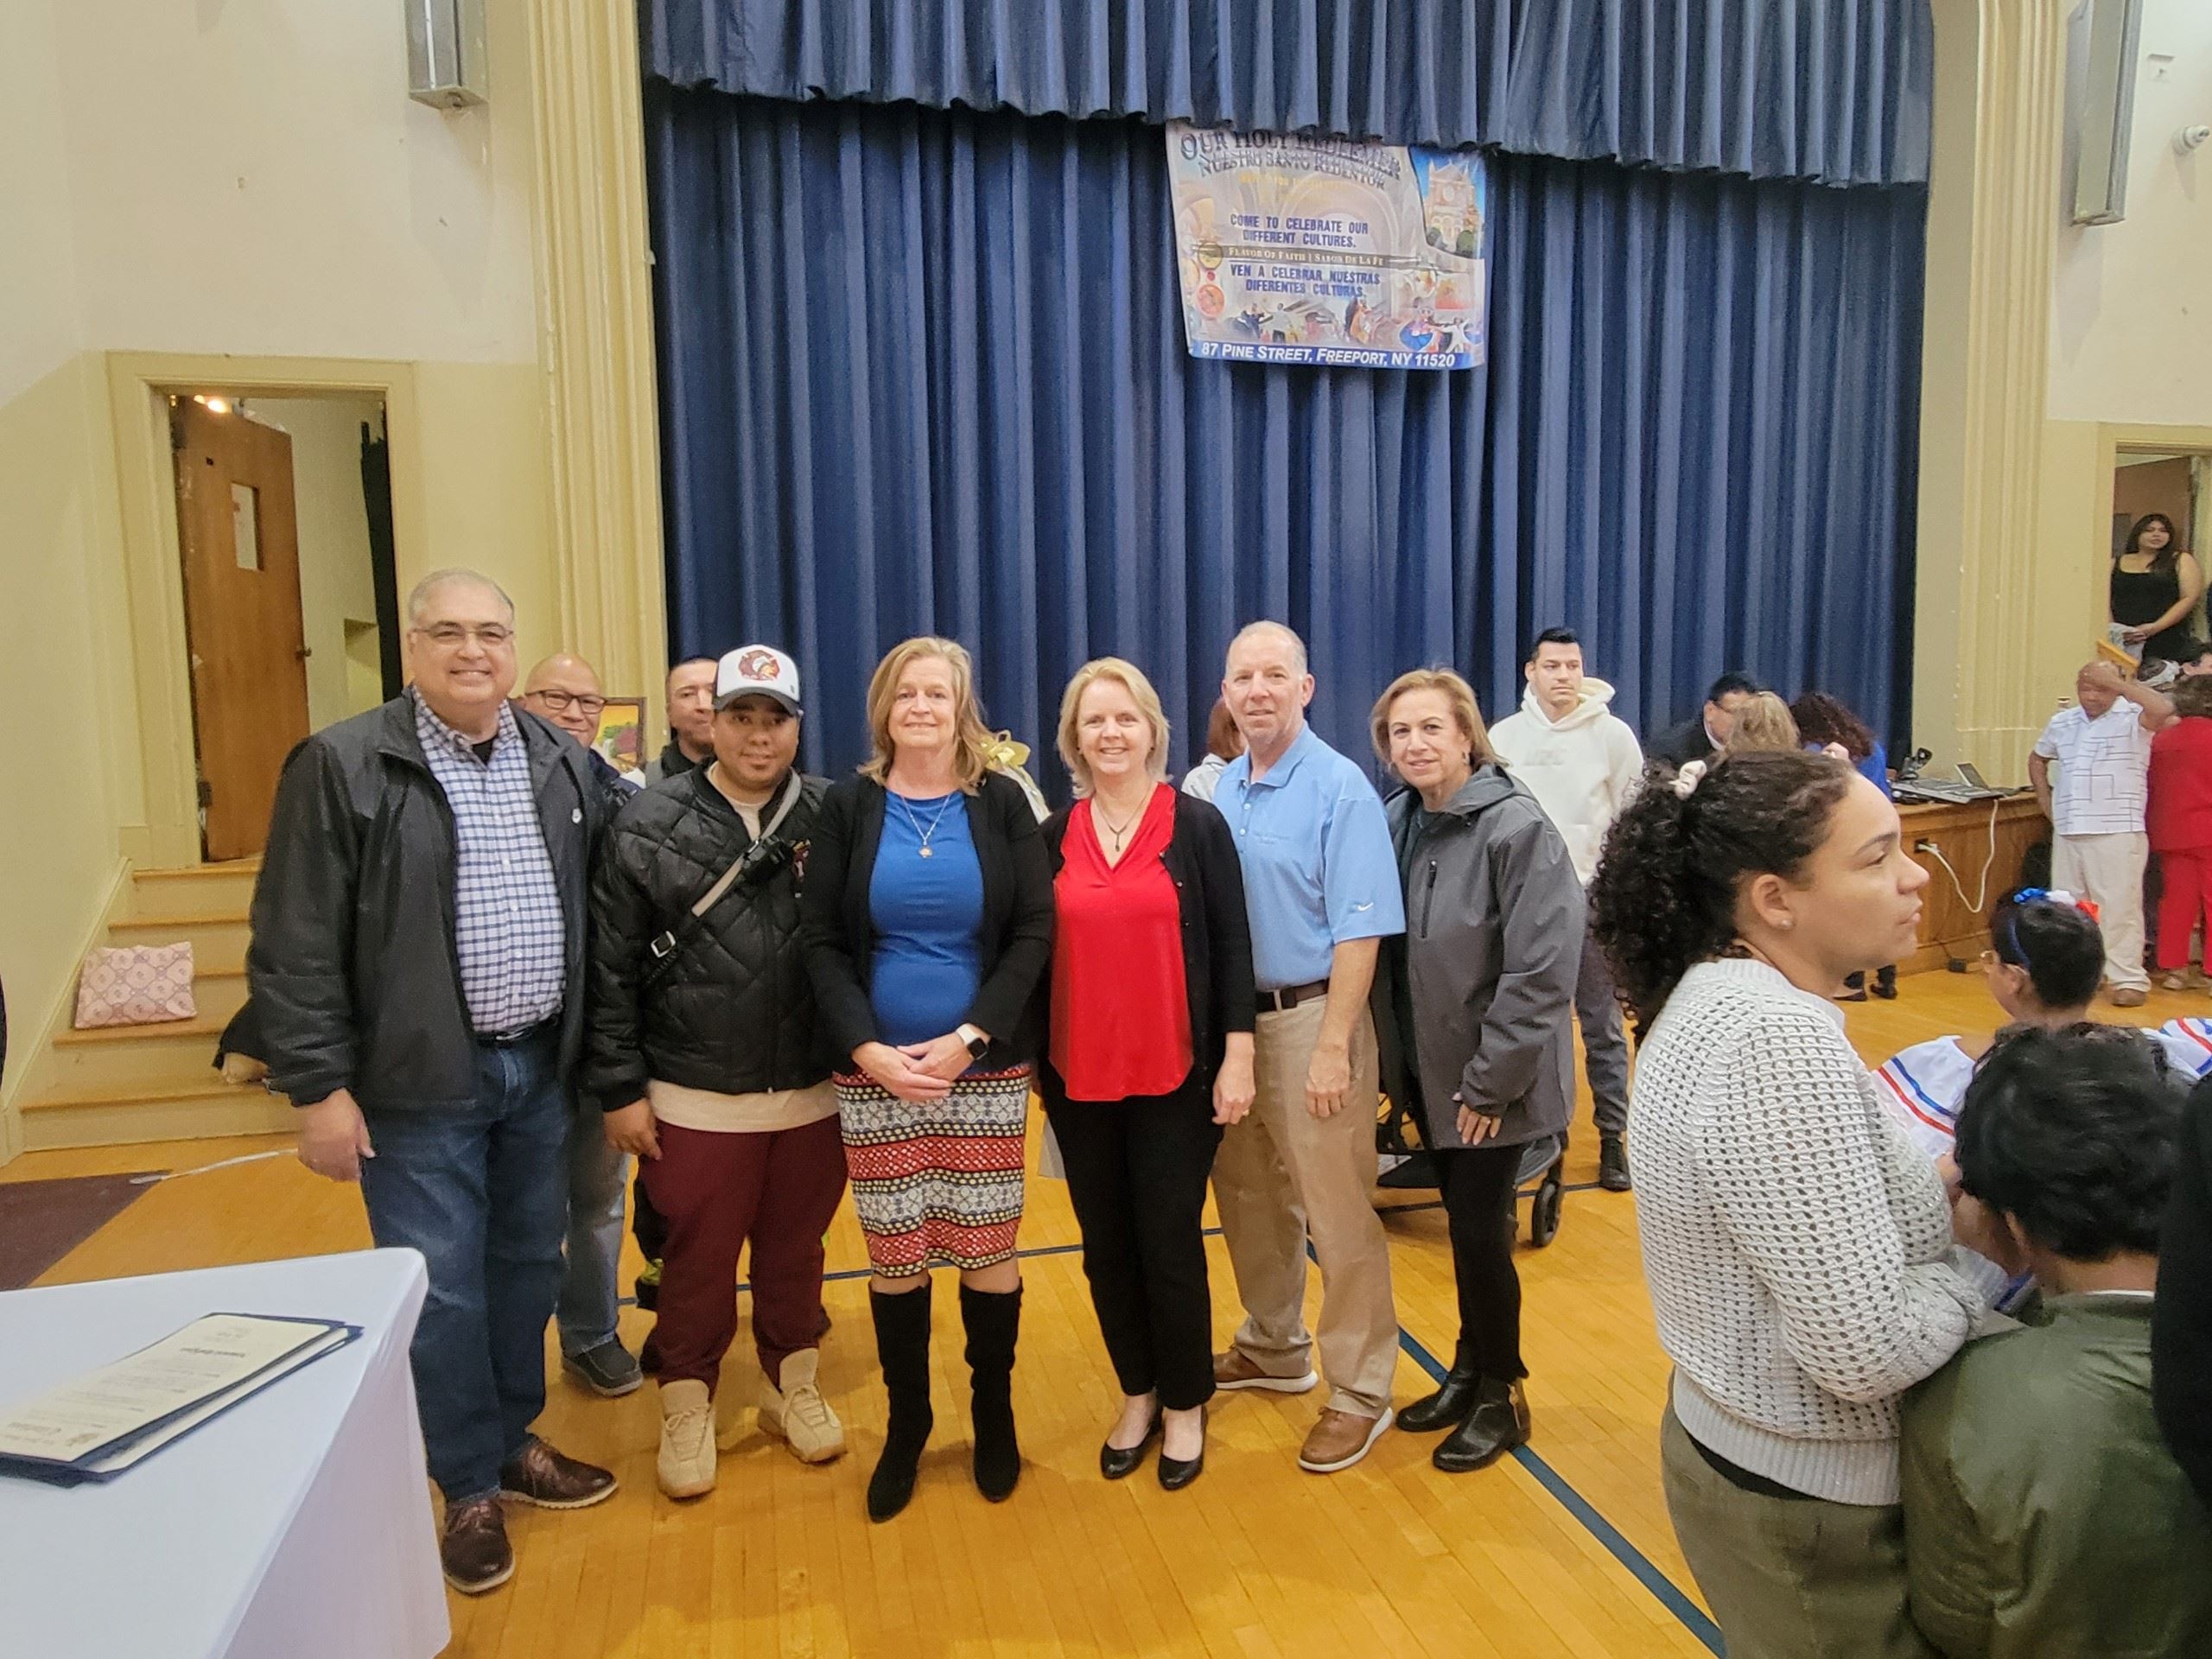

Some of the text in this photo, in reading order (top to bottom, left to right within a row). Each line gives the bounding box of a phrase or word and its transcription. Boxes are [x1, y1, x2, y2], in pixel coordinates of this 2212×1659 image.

[1180, 130, 1228, 160] OUR
[1230, 213, 1369, 235] COME TO CELEBRATE OUR
[1243, 229, 1357, 248] DIFFERENT CULTURES.
[1230, 264, 1381, 285] VEN A CELEBRAR NUESTRAS
[1245, 279, 1367, 298] DIFERENTES CULTURAS.
[1202, 342, 1456, 367] 87 PINE STREET, FREEPORT, NY 11520
